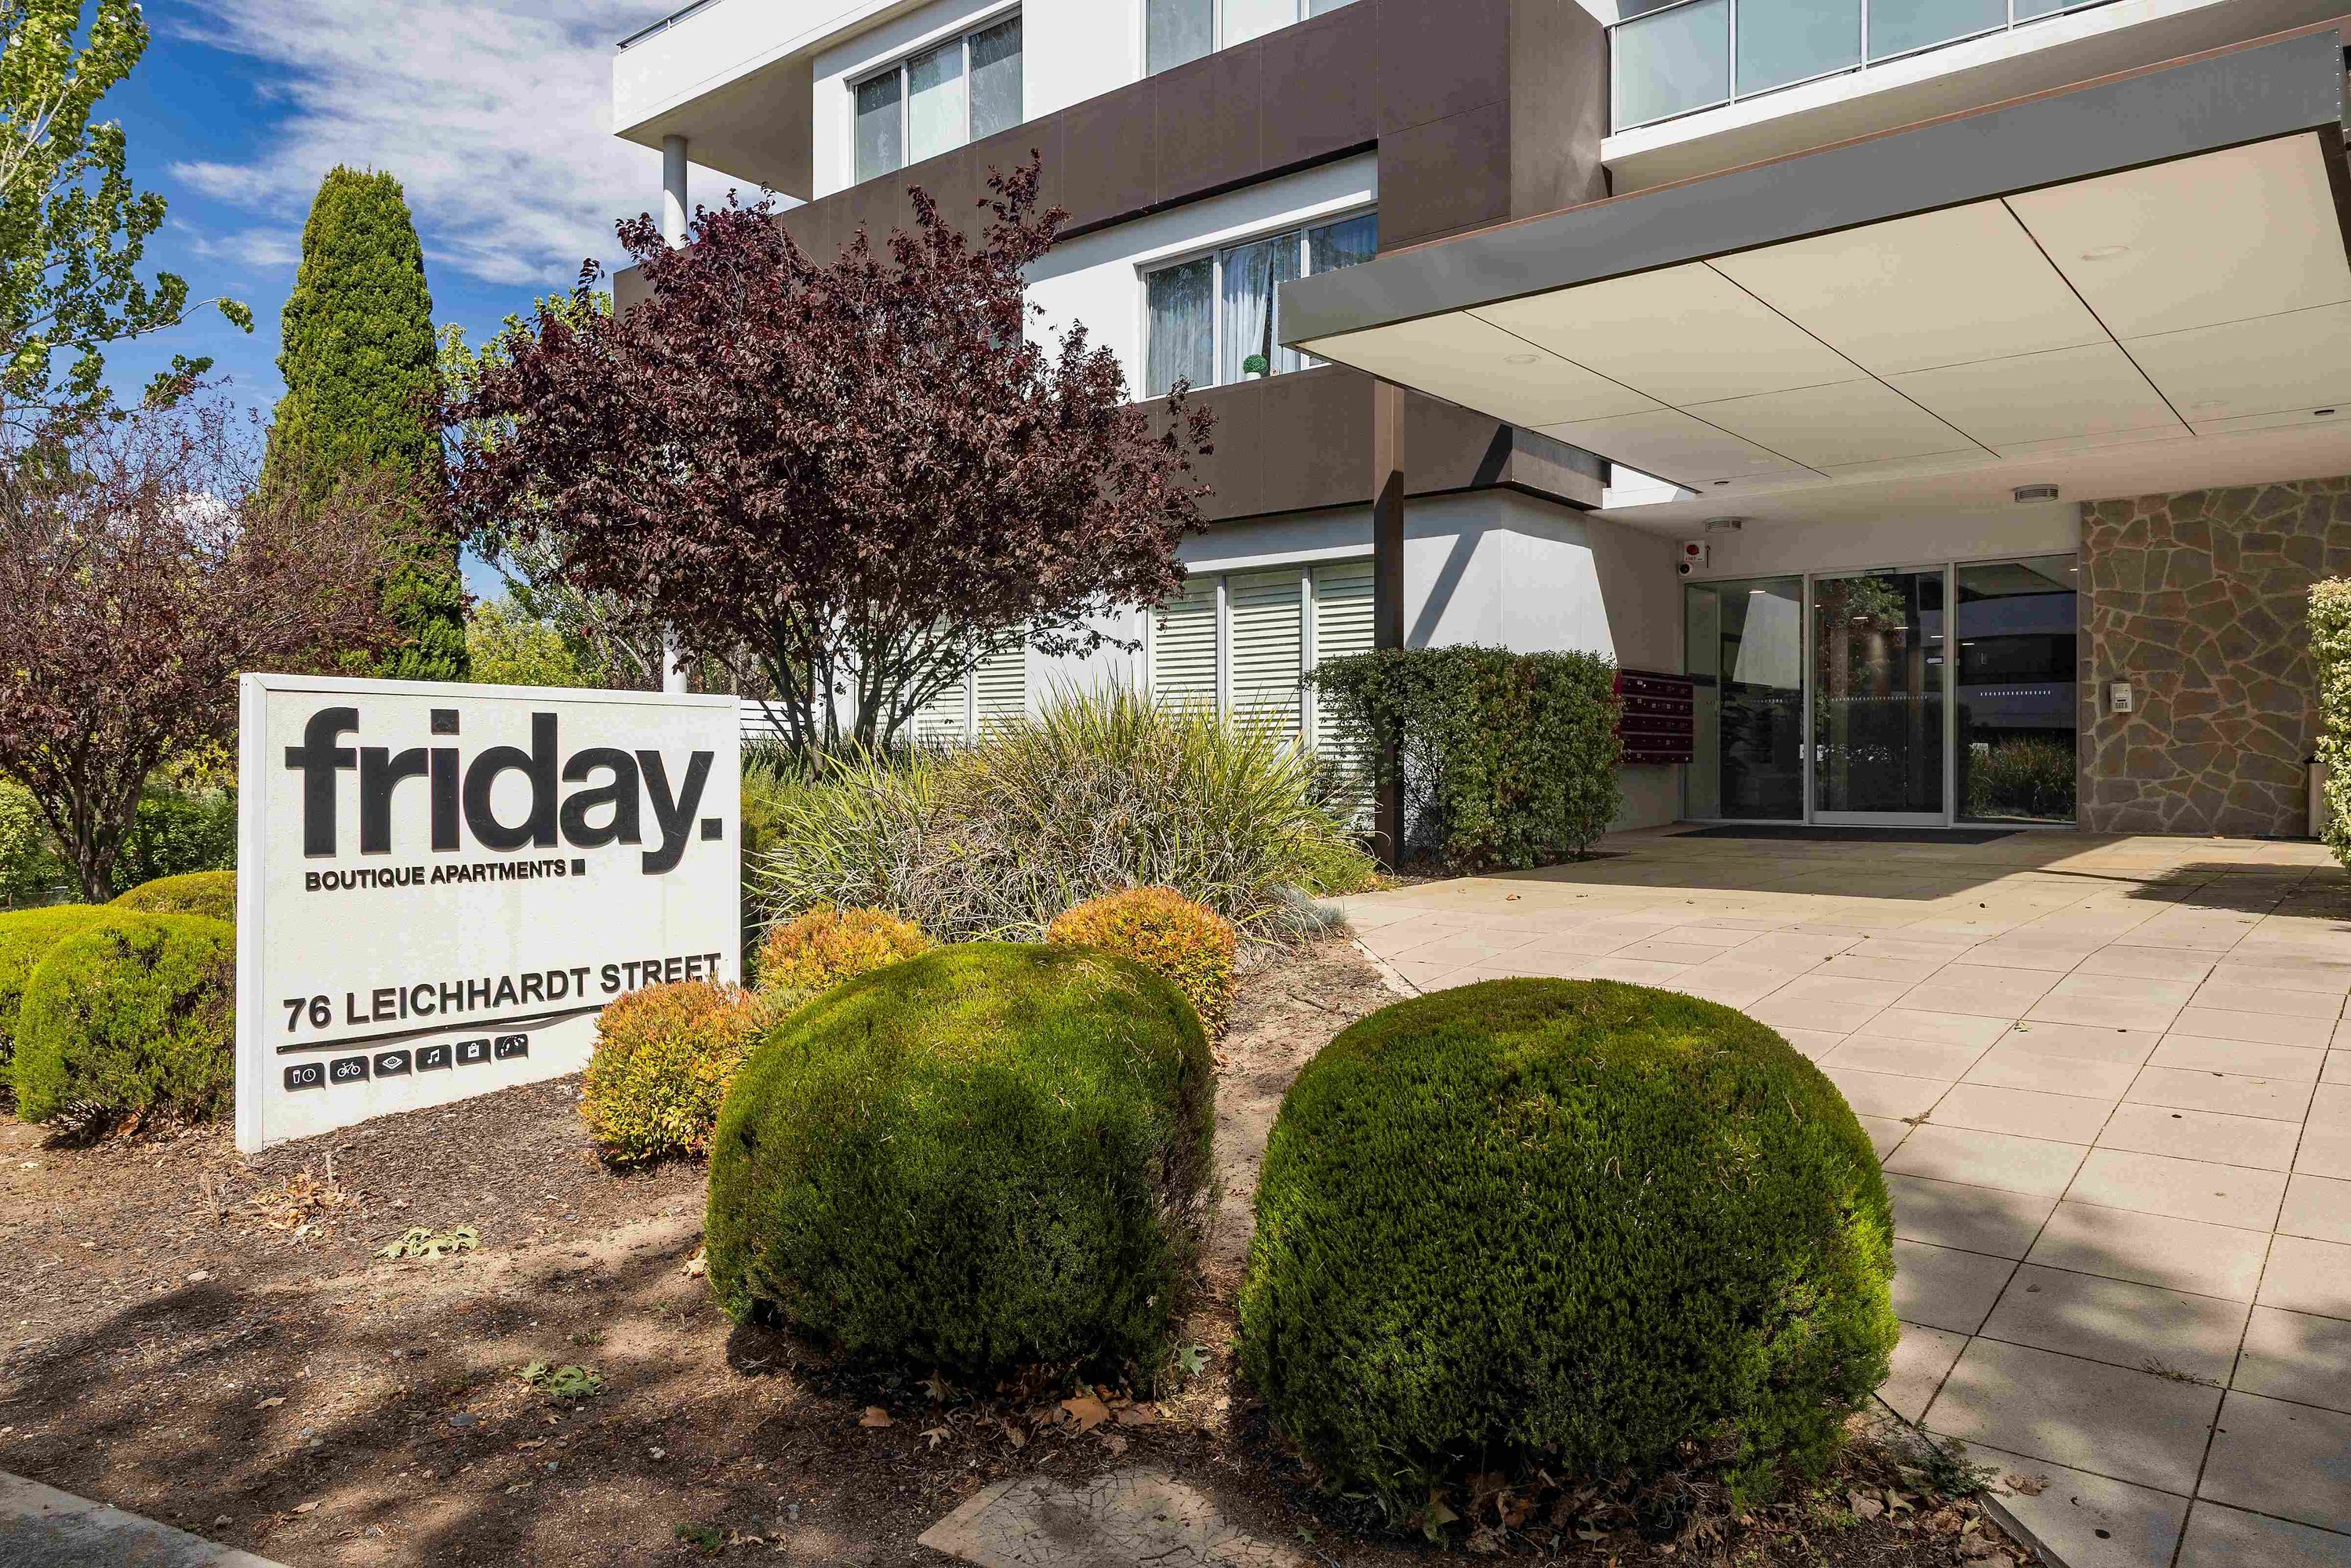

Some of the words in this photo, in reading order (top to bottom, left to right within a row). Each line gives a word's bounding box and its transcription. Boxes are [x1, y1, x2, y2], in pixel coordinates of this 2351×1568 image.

[285, 706, 722, 875] friday.
[305, 866, 426, 892] BOUTIQUE
[431, 859, 566, 884] APARTMENTS
[283, 995, 332, 1033] 76
[346, 967, 590, 1025] LEICHHARDT
[601, 953, 721, 994] STREET
